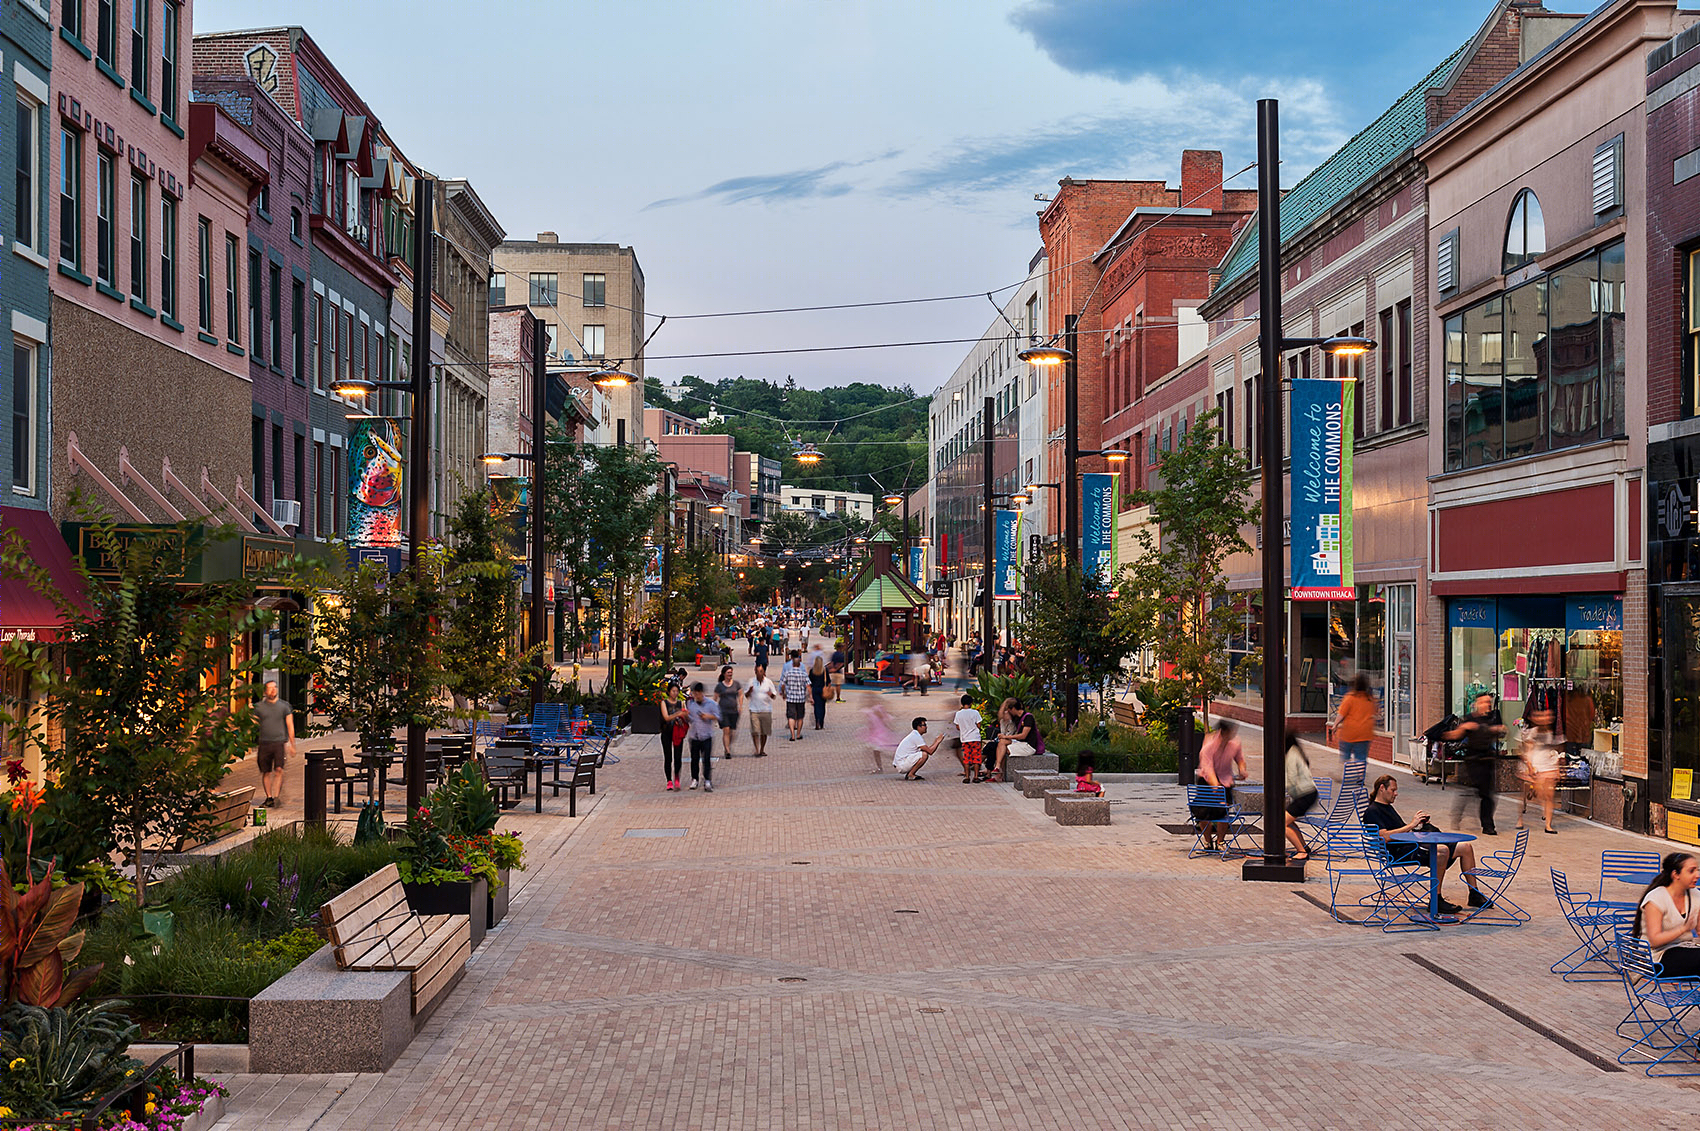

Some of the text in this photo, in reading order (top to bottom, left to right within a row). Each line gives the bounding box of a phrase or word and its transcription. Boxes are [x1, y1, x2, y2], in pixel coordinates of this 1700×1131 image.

[1303, 403, 1321, 502] Welcome to
[1324, 403, 1341, 504] THE COMMONS
[1001, 519, 1010, 562] Welcome to
[1010, 519, 1018, 550] COMMONS
[1089, 487, 1101, 544] Welcome to
[1102, 487, 1112, 545] THE COMMONS
[1578, 603, 1606, 621] Trader
